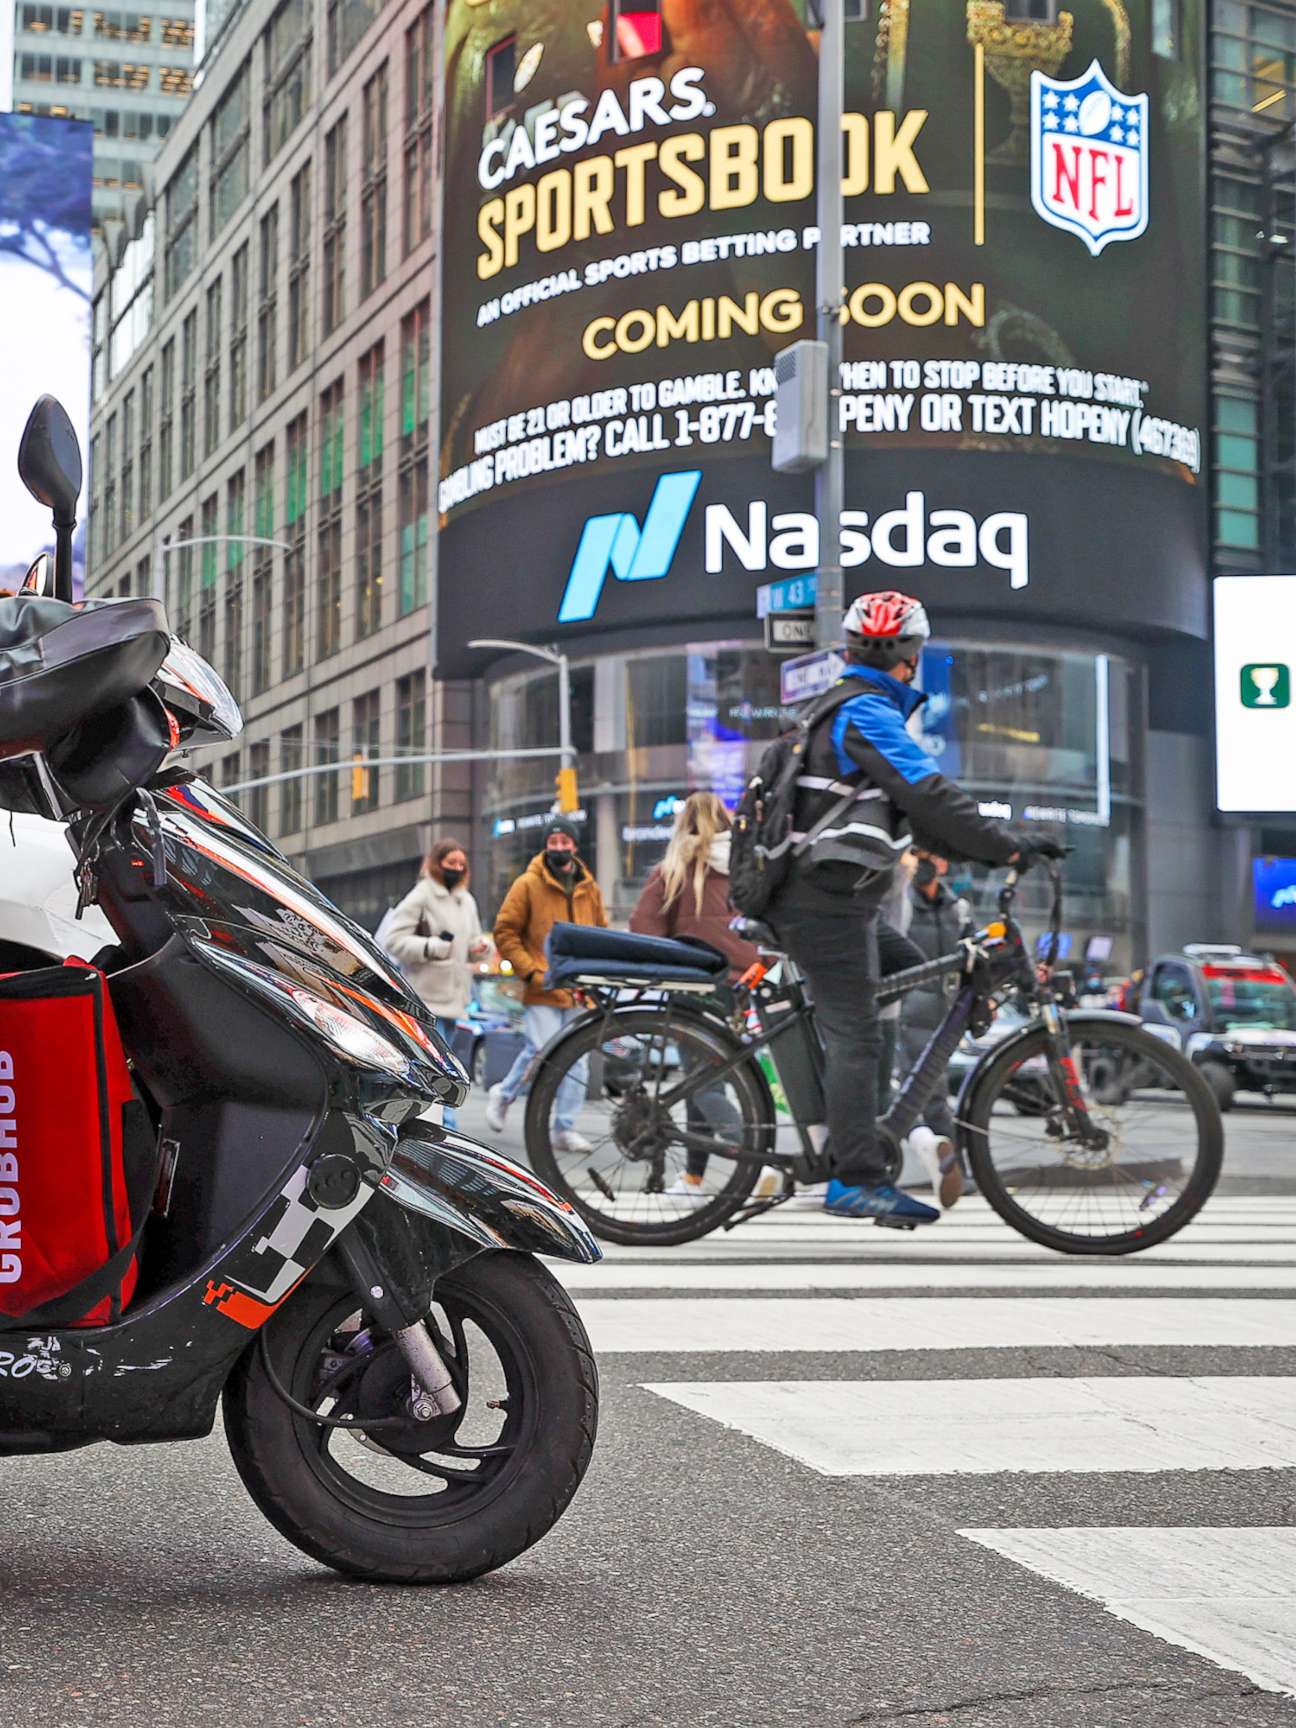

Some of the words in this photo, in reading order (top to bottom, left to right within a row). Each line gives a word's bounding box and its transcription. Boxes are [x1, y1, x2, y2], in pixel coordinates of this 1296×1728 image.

[477, 110, 931, 280] SPORTSBOOK
[1052, 143, 1135, 222] NFL
[476, 298, 501, 327] AN
[501, 269, 583, 315] OFFICIAL
[584, 245, 678, 286] SPORTS
[681, 228, 797, 265] BETTING
[802, 221, 931, 250] PRTNER
[582, 287, 804, 361] COMING
[474, 418, 507, 455] MUST
[507, 412, 527, 442] BE
[526, 406, 546, 435] 21
[546, 400, 571, 430] OR
[571, 388, 628, 424] OLDER
[629, 382, 656, 412] TO
[658, 370, 746, 408] GAMBLE.
[839, 360, 887, 390] HEN
[889, 360, 921, 389] TO
[923, 360, 980, 389] STOP
[982, 362, 1056, 394] BEFORE
[1056, 367, 1093, 398] YOU
[495, 424, 602, 485] PROBLEM?
[604, 413, 671, 457] CALL
[920, 393, 962, 431] OR
[967, 394, 1037, 435] TEXT
[1040, 399, 1131, 446] HOPENY
[705, 491, 1029, 590] Nasdaq
